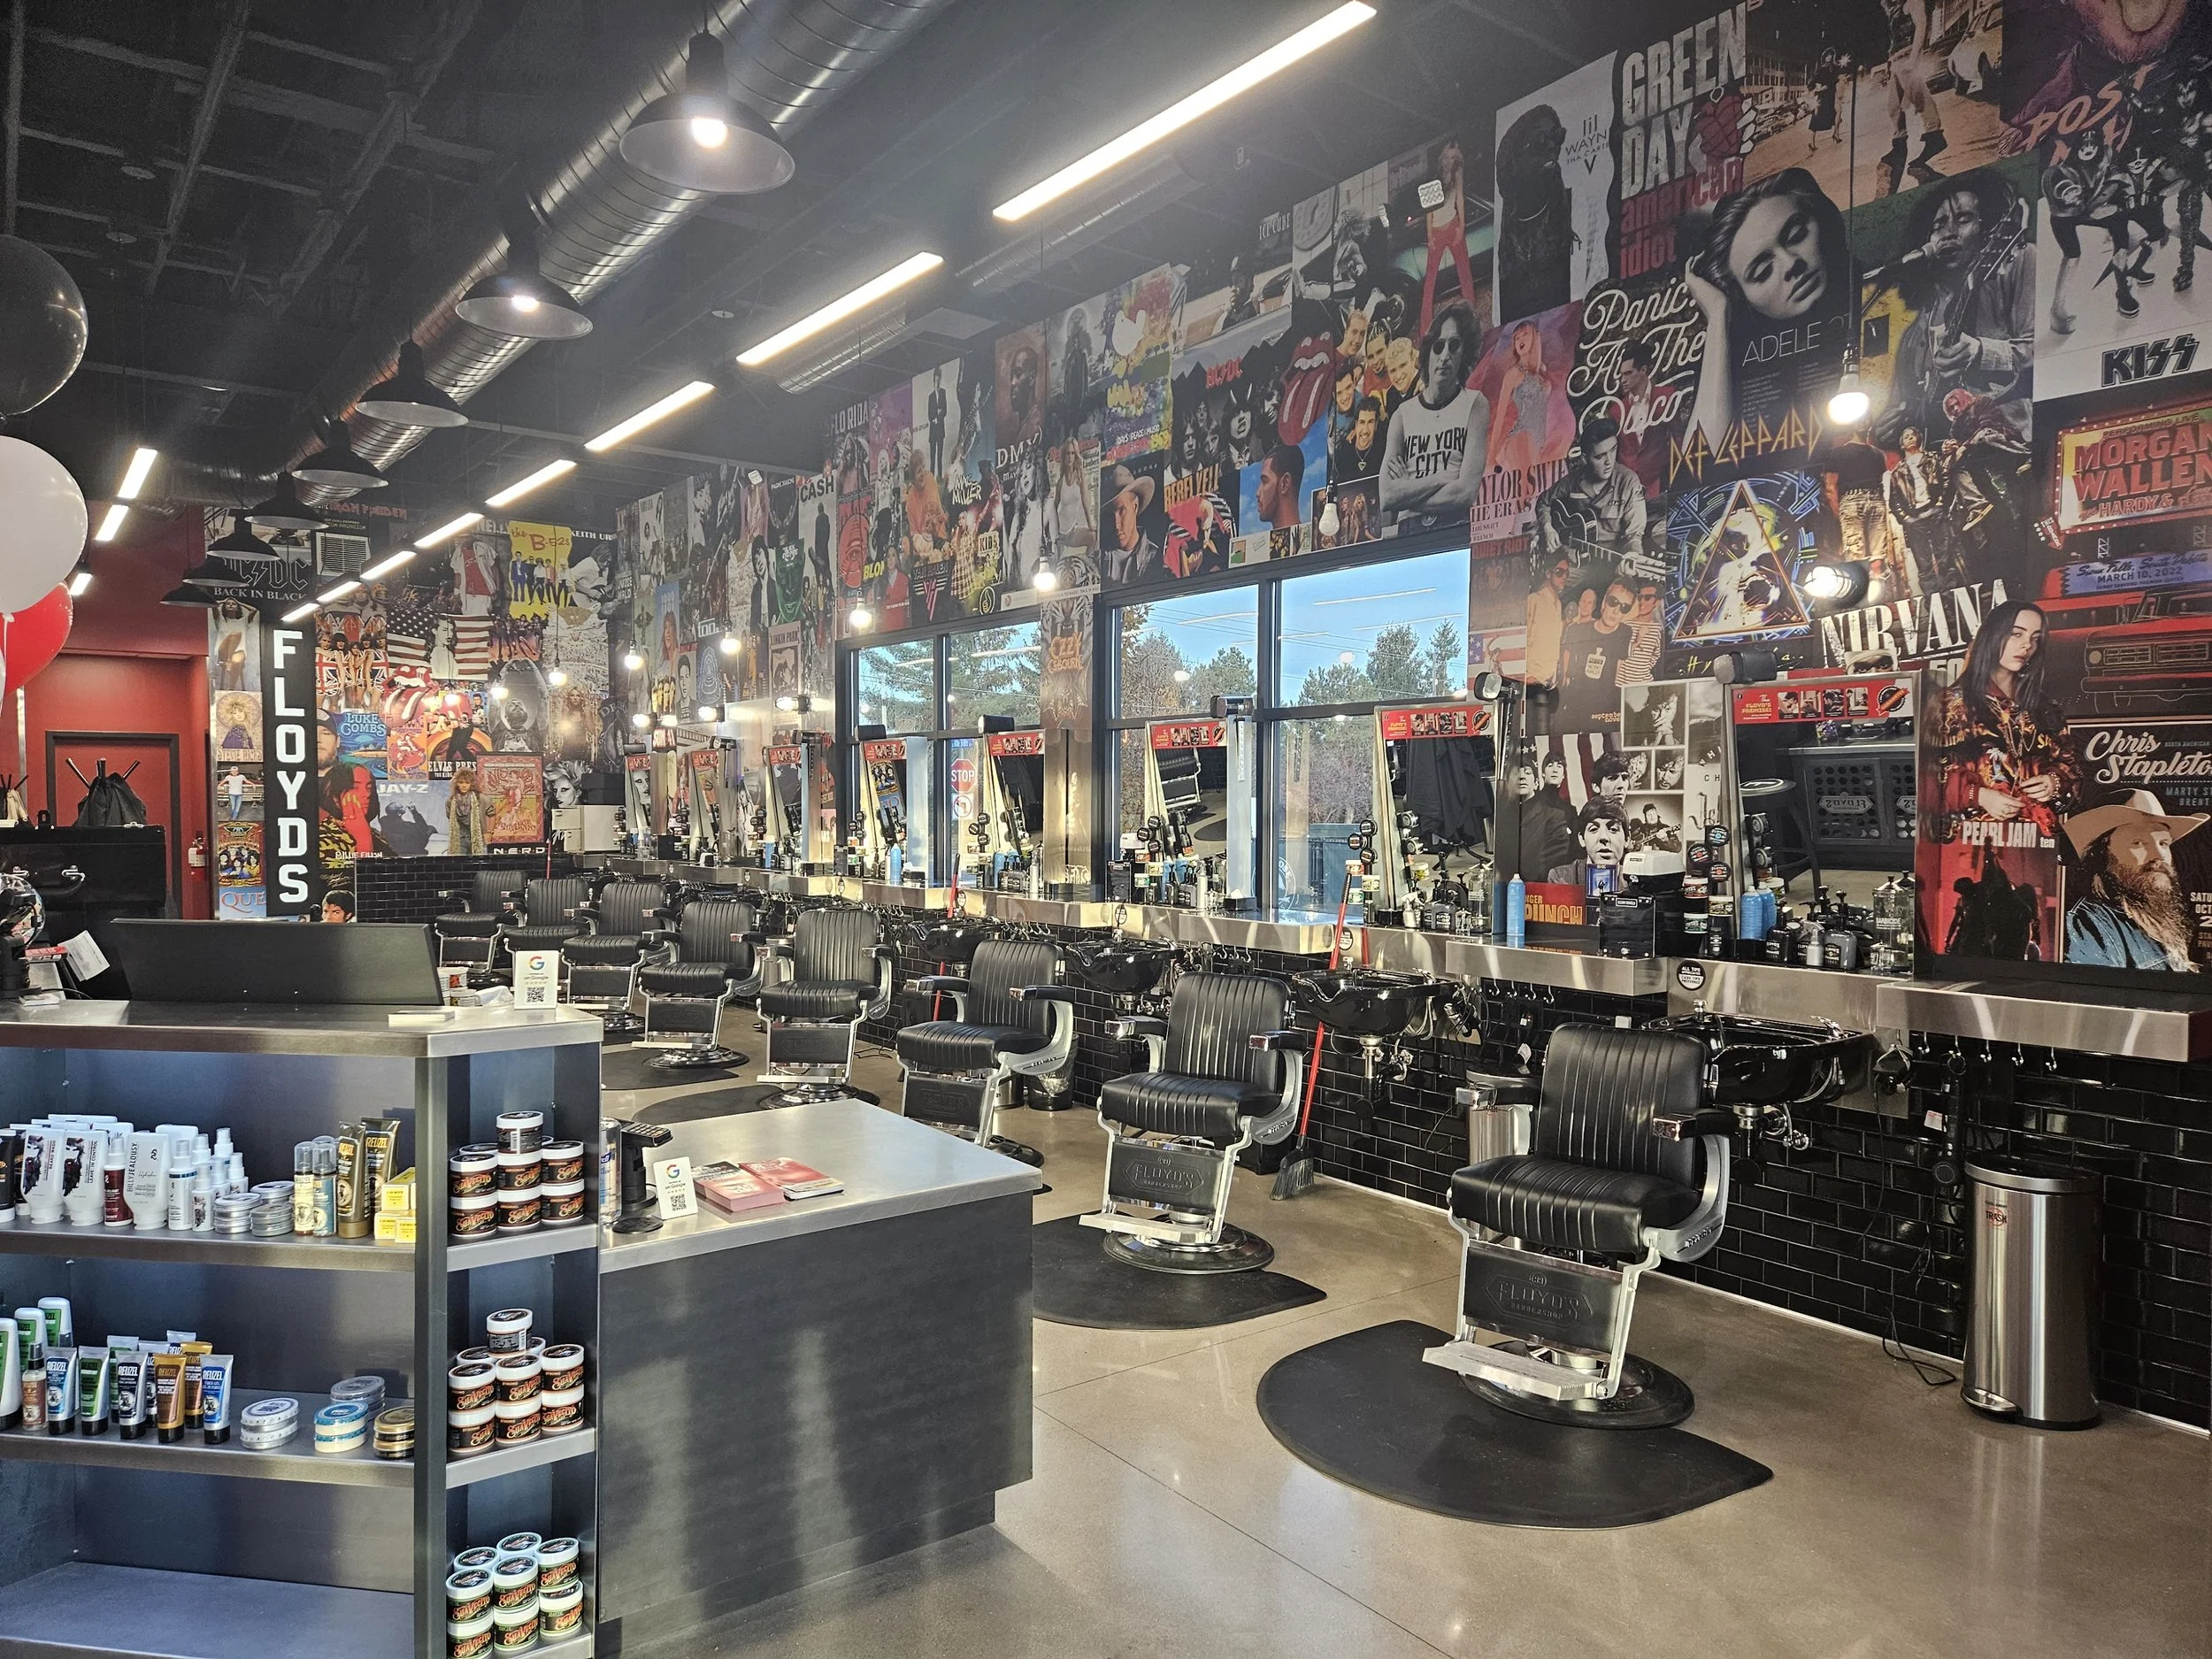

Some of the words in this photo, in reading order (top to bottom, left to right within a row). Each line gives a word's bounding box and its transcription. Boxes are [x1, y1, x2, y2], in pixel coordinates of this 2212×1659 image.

[1622, 2, 1747, 127] GREEN
[1583, 113, 1597, 136] lil
[1565, 129, 1609, 156] WAYN
[1621, 101, 1694, 200] DAY
[1585, 155, 1596, 174] V
[1620, 224, 1678, 279] idiot
[1641, 312, 1707, 379] The
[1742, 321, 1822, 367] ADELE
[2101, 334, 2200, 387] KISS
[1405, 434, 1431, 462] NEW
[1670, 420, 1708, 487] DEF
[1715, 402, 1824, 468] LEPPARD
[2074, 421, 2212, 472] MORGAN
[1416, 450, 1452, 479] CITY
[800, 475, 834, 503] CASH
[1474, 470, 1524, 506] AYLOR
[2072, 452, 2212, 503] WALLEN
[952, 485, 982, 505] MILLER
[2099, 495, 2159, 518] HARDY
[2159, 493, 2174, 509] &
[1471, 505, 1490, 523] HE
[511, 526, 529, 538] the
[2097, 573, 2134, 583] MARCH
[2156, 566, 2182, 575] 2022
[214, 587, 248, 597] BACK
[250, 589, 264, 599] IN
[340, 723, 387, 737] COMBS
[346, 712, 379, 724] LUKE
[218, 747, 241, 761] STEVIE
[2086, 730, 2162, 761] Chris
[273, 629, 310, 903] FLOYDS
[428, 760, 453, 772] ELVIS
[951, 770, 975, 782] STOP
[2097, 750, 2212, 785] Stapleto
[377, 784, 429, 794] JAY-Z
[2166, 787, 2199, 796] MARTY
[1962, 821, 2005, 847] PEARL
[2006, 822, 2037, 848] JAM
[2039, 837, 2055, 848] ten
[221, 891, 266, 913] QUE
[1525, 895, 1543, 903] NGER
[1525, 904, 1583, 925] PUNCH
[366, 1137, 388, 1148] REUZEL
[1985, 1210, 2008, 1224] TRASH
[1499, 1282, 1580, 1320] FLOYD'S
[118, 1365, 138, 1376] REUZEL
[203, 1370, 223, 1380] REUZEL
[541, 1561, 577, 1586] SUAVECITO
[498, 1581, 536, 1607] SUAVECITO
[453, 1595, 490, 1620] SUAVECITO
